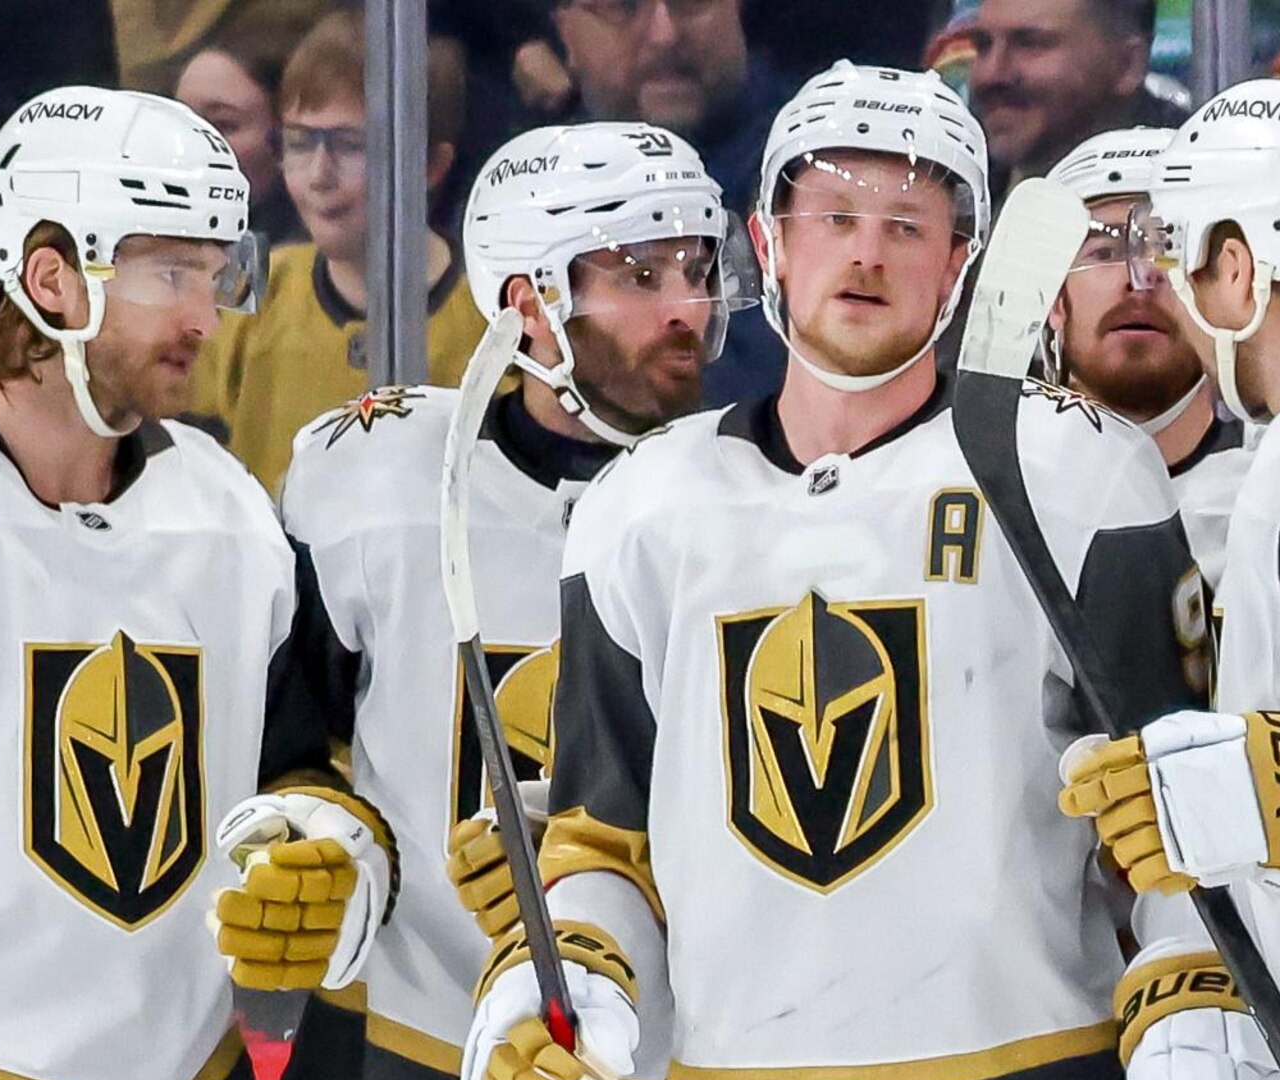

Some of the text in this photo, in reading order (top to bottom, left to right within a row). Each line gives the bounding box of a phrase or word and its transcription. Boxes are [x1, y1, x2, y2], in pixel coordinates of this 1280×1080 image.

[38, 103, 104, 121] NAQVI
[853, 99, 922, 116] BAUER
[1101, 149, 1166, 160] BAUE
[507, 154, 560, 176] NAQVI
[209, 186, 245, 201] CCM
[924, 486, 987, 585] A
